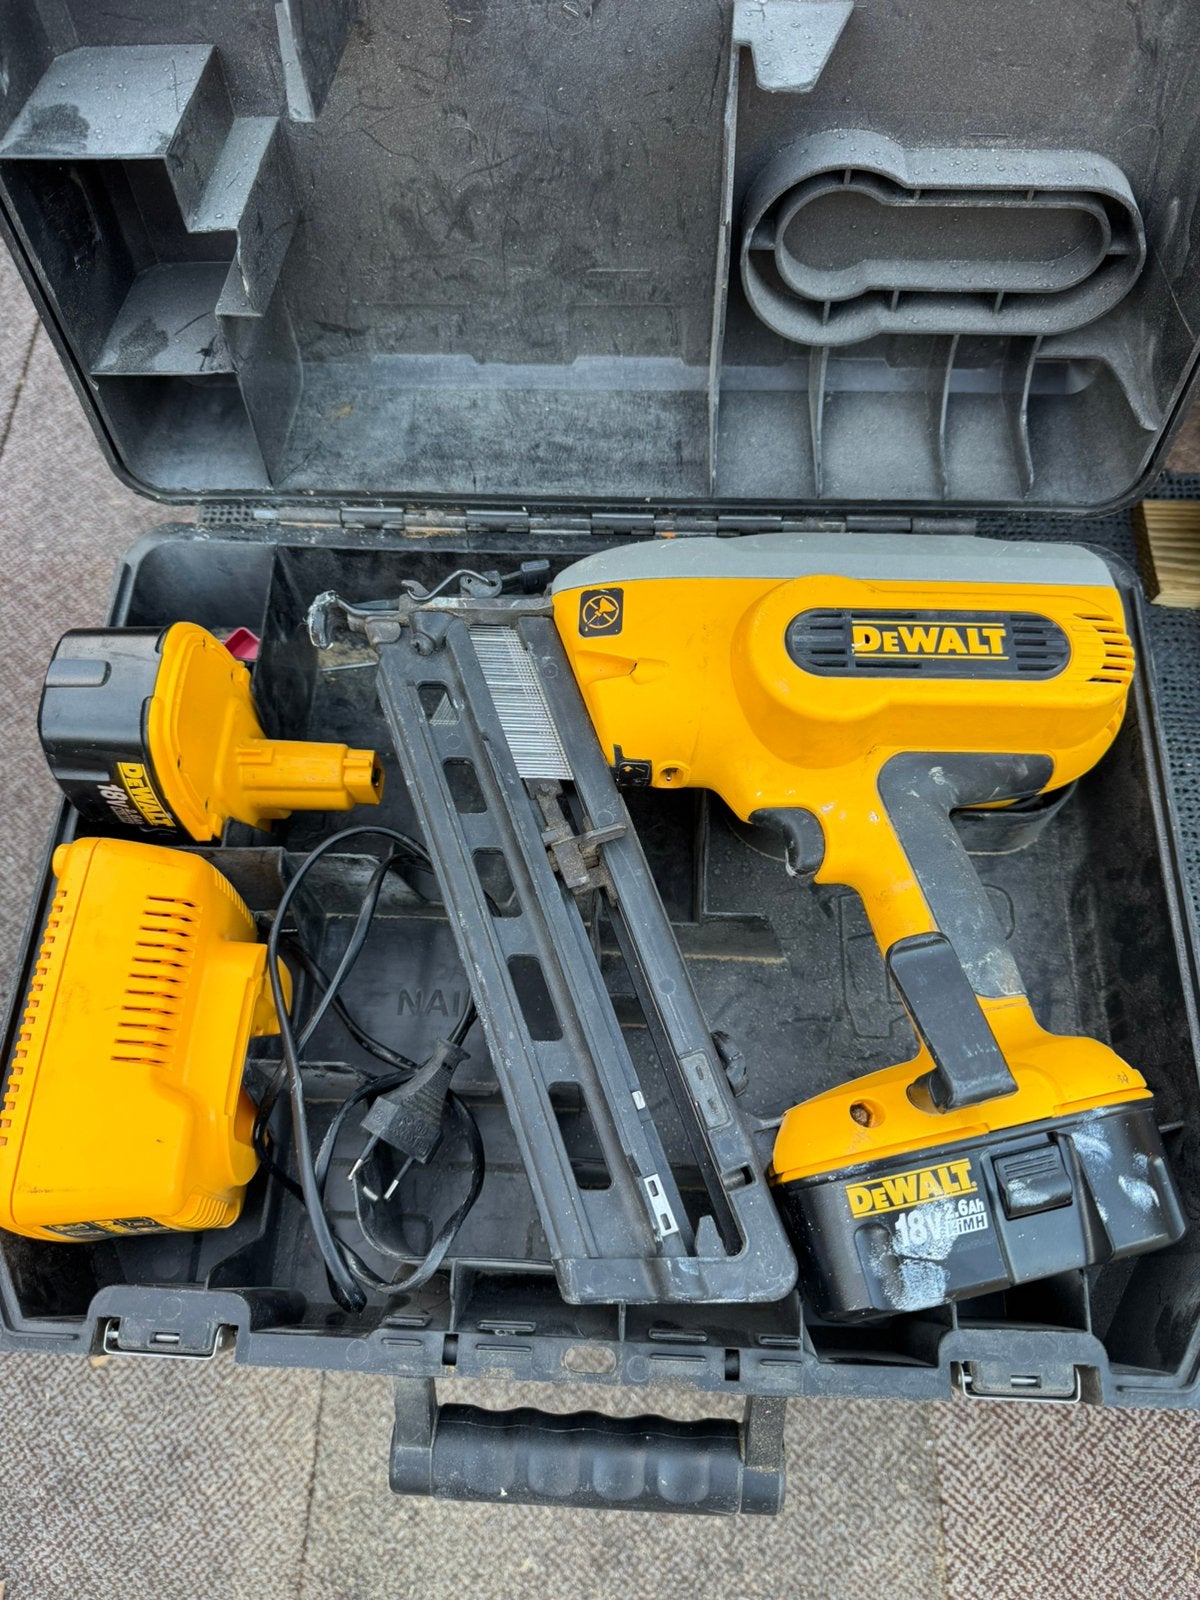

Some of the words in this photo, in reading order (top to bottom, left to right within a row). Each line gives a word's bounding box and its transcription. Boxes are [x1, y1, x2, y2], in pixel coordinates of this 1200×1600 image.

[397, 988, 461, 1017] NAI
[942, 1198, 985, 1220] 2.6Ah
[894, 1206, 943, 1247] 18V
